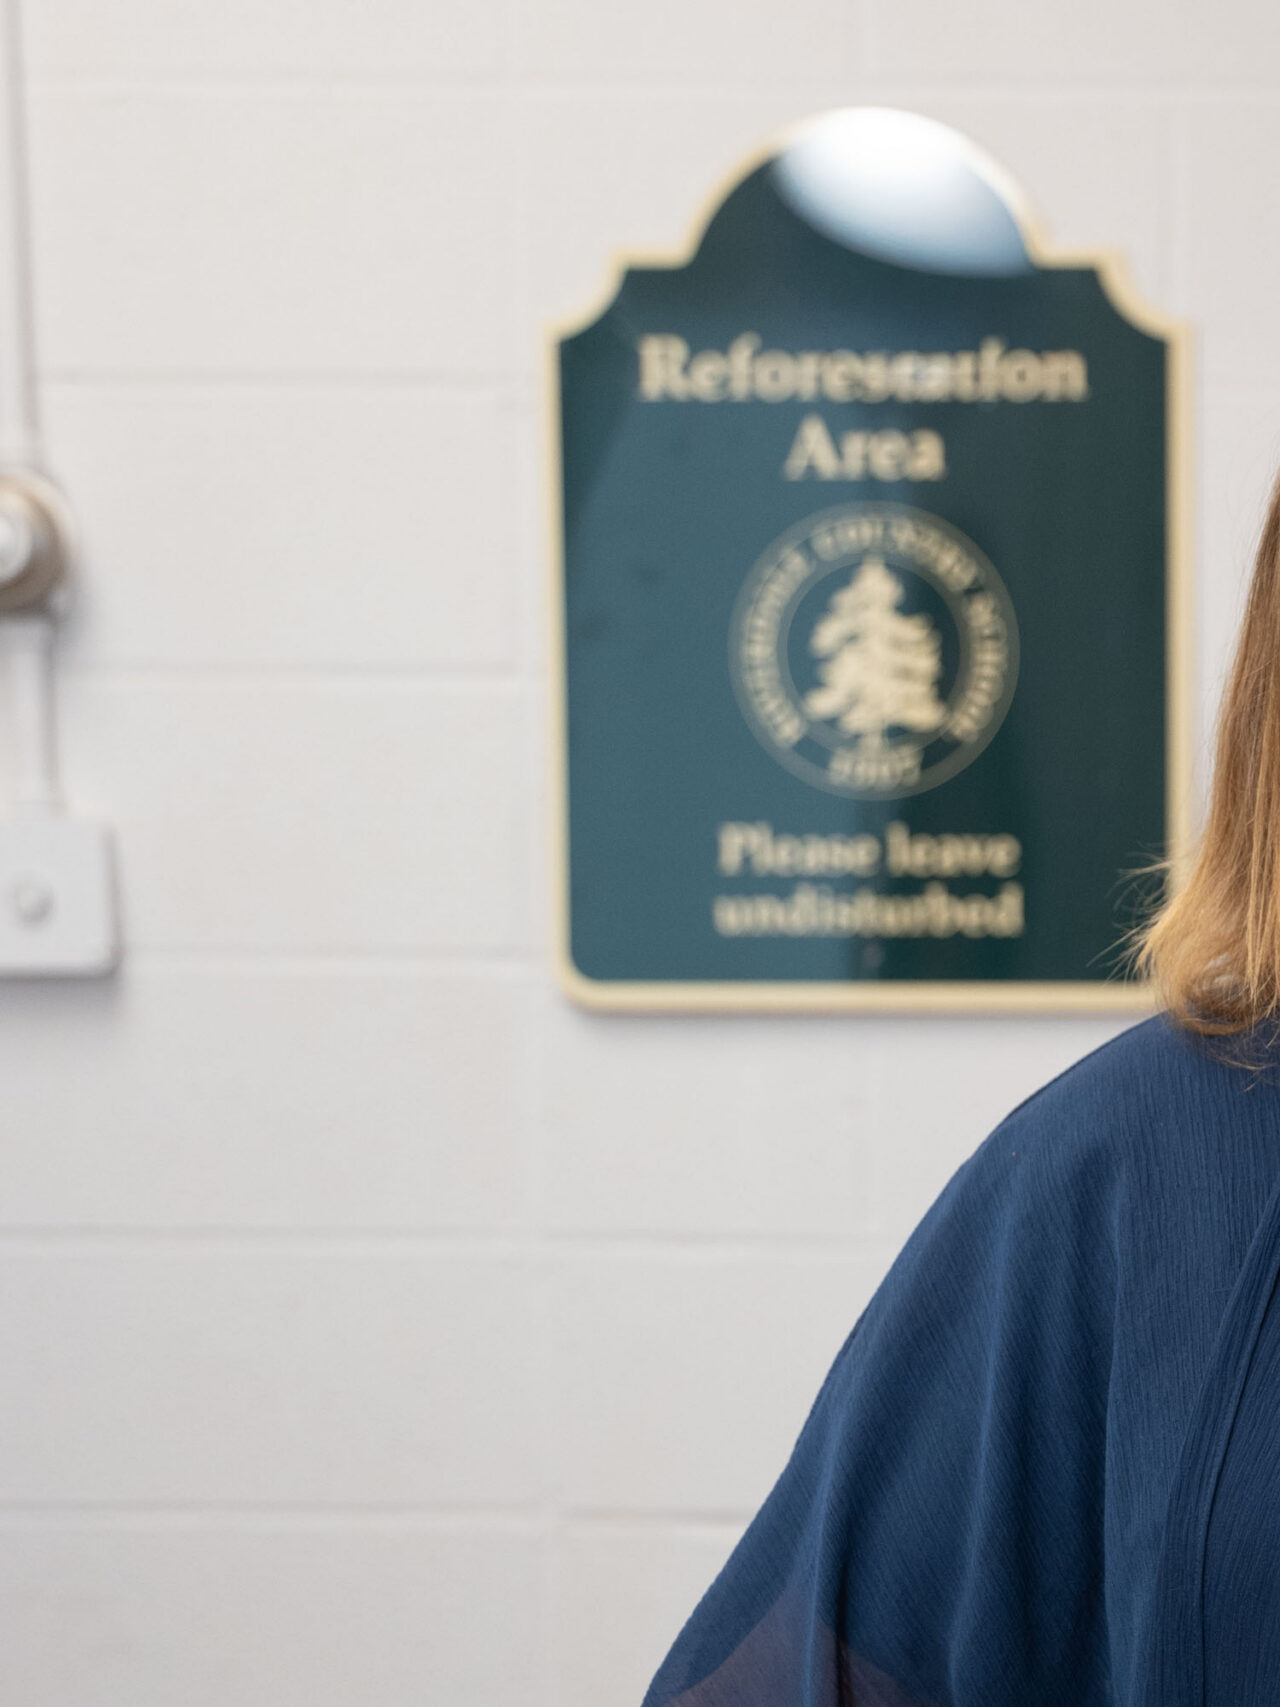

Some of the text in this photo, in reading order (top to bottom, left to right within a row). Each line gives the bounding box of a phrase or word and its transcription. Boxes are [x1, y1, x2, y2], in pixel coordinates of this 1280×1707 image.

[640, 333, 1089, 402] Reforestation
[784, 415, 946, 481] Area
[719, 821, 1021, 877] Please leave
[714, 882, 1024, 937] undisturbed
